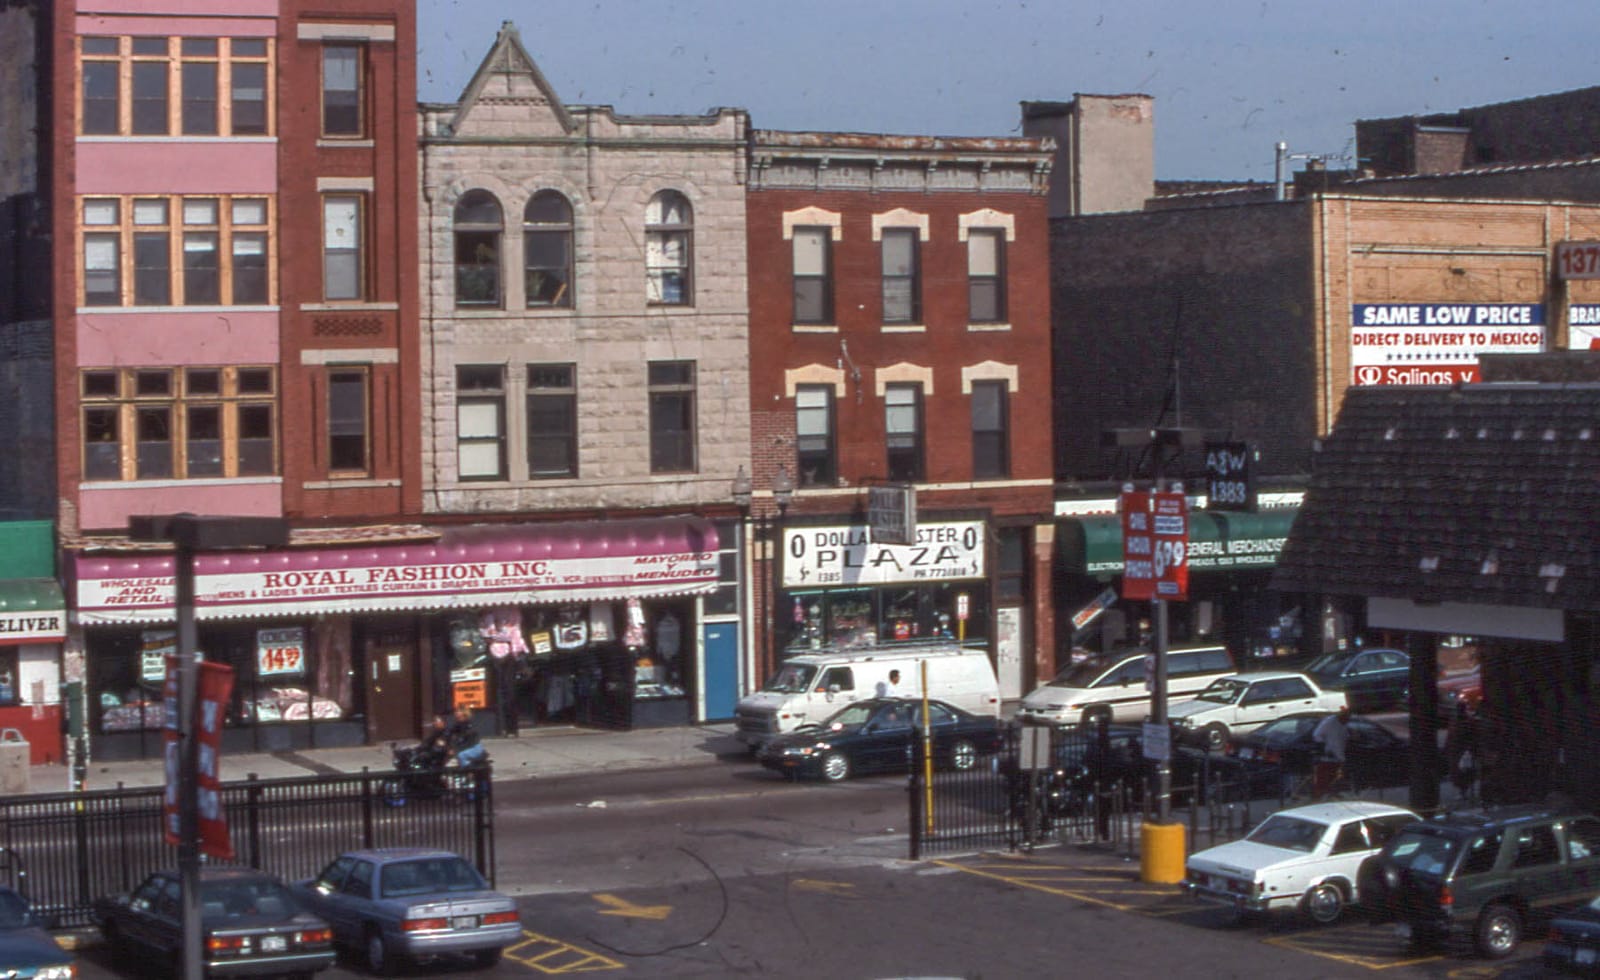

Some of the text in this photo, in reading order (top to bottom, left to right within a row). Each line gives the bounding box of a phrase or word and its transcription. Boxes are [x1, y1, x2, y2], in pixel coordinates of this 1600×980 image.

[1562, 248, 1600, 273] 137
[1363, 306, 1531, 325] SAME LOW PRICE
[1353, 332, 1545, 346] DIRECT DELIVERY TO MEXICO!
[1386, 367, 1454, 385] Salinas
[1211, 481, 1247, 503] 1383
[814, 526, 959, 548] DOLLA STER
[1186, 541, 1225, 556] GENERAL
[633, 553, 713, 565] MAYOREO
[666, 562, 678, 570] Y
[816, 545, 960, 572] PLAZA
[263, 562, 553, 588] ROYAL FASHION INC.
[634, 567, 715, 580] MENUDEO
[818, 572, 842, 582] 1385
[101, 577, 176, 589] WHOLESALE
[218, 590, 246, 598] MENS
[250, 589, 257, 598] &
[262, 588, 297, 597] LADIES
[302, 586, 330, 595] WEAR
[441, 579, 479, 588] DRAPES
[483, 577, 540, 587] ELECTRONIC
[119, 586, 157, 596] AND
[104, 594, 164, 604] RETAIL
